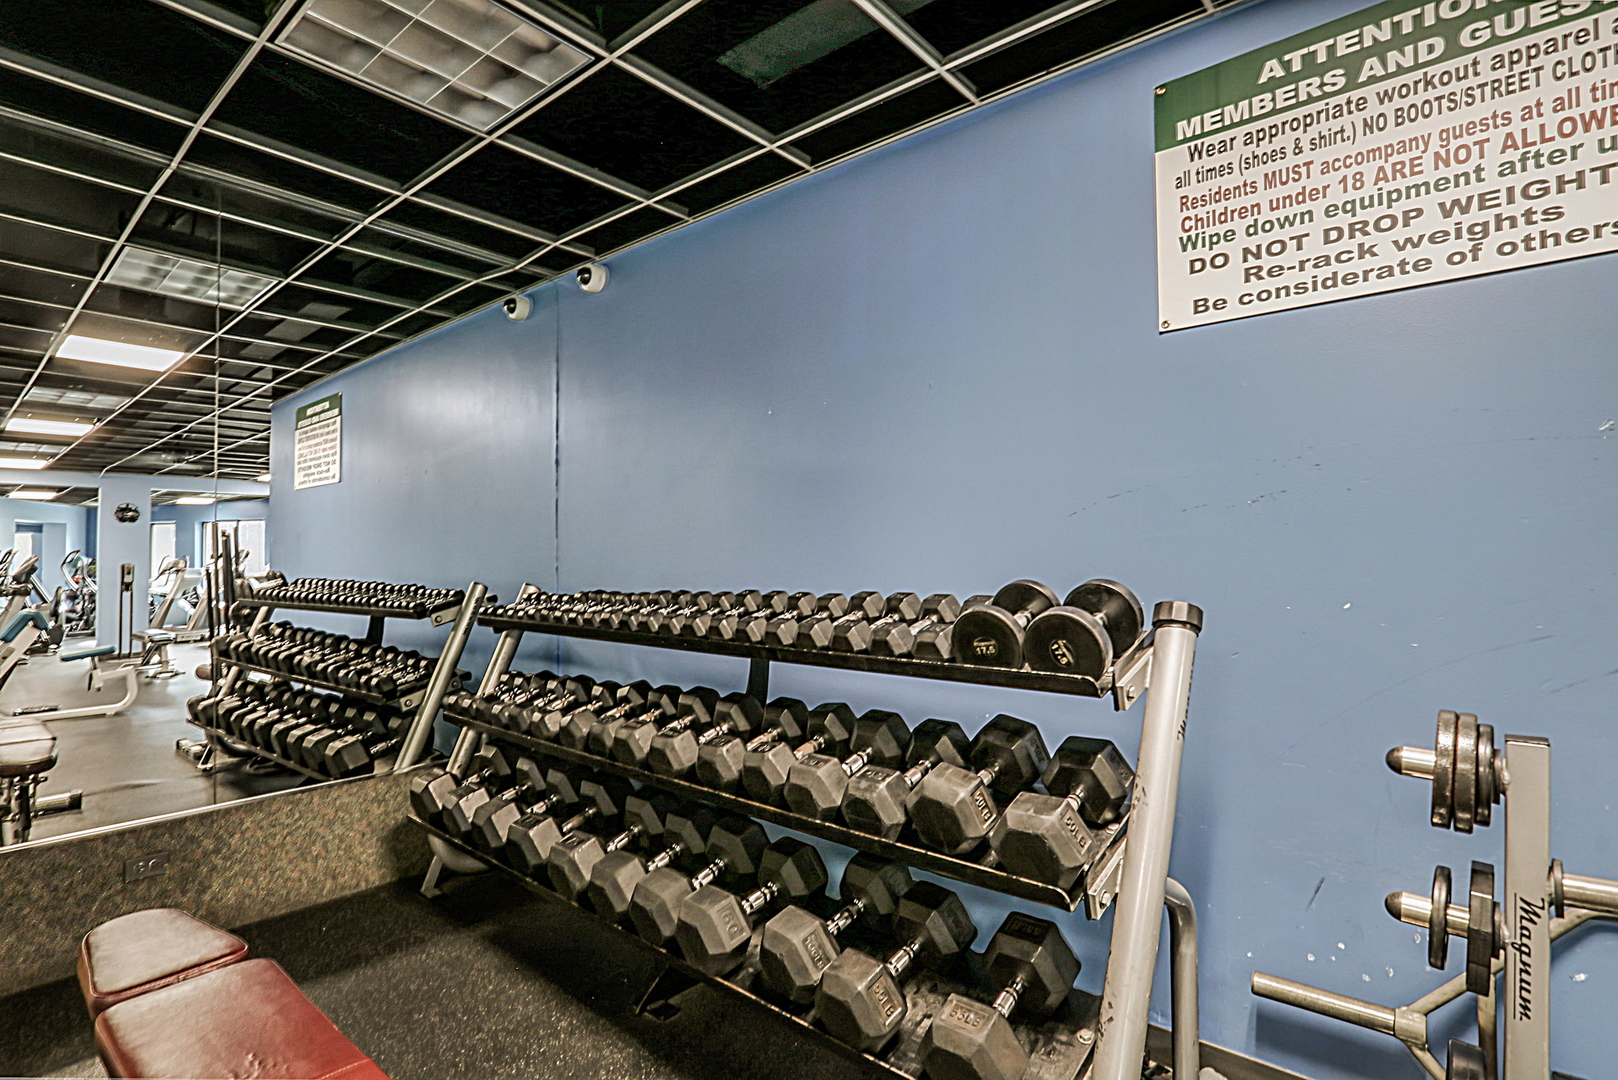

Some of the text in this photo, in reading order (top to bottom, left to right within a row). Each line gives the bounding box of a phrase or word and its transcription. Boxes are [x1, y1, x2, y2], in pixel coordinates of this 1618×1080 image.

[1176, 68, 1347, 141] MEMBERS
[1357, 36, 1446, 83] AND
[1458, 0, 1618, 48] GUES
[1187, 135, 1237, 163] Wear
[1242, 95, 1368, 148] appropriate
[1375, 55, 1481, 106] workout
[1490, 17, 1600, 72] apparel
[1175, 170, 1191, 190] all
[1195, 161, 1234, 185] times
[1238, 144, 1287, 176] (shoes
[1292, 137, 1304, 156] &
[1309, 120, 1357, 151] shirt.)
[1362, 112, 1388, 137] NO
[1393, 65, 1545, 128] BOOTS/STREET
[1179, 178, 1258, 213] Residents
[1263, 160, 1314, 191] MUST
[1320, 132, 1432, 176] accompany
[1438, 109, 1513, 149] guests
[1520, 97, 1544, 123] at
[1551, 86, 1581, 114] all
[1178, 228, 1237, 253] Wipe
[1244, 208, 1314, 238] down
[1323, 162, 1486, 219] equipment
[1497, 142, 1585, 178] after
[1180, 202, 1262, 234] Children
[1268, 183, 1331, 213] under
[1338, 171, 1365, 195] 18
[1373, 155, 1424, 186] ARE
[1433, 137, 1491, 172] NOT
[1188, 252, 1230, 275] DO
[1241, 232, 1310, 264] NOT
[1322, 207, 1425, 246] DROP
[1192, 297, 1229, 315] Be
[1237, 257, 1433, 306] considerate
[1445, 242, 1484, 266] of
[1243, 205, 1565, 284] Re-rack weights
[975, 646, 996, 656] 17.5
[973, 792, 992, 822] 50LB
[1063, 815, 1088, 850] 50LB
[872, 983, 895, 1018] 55LB
[1511, 896, 1546, 1021] Magnum
